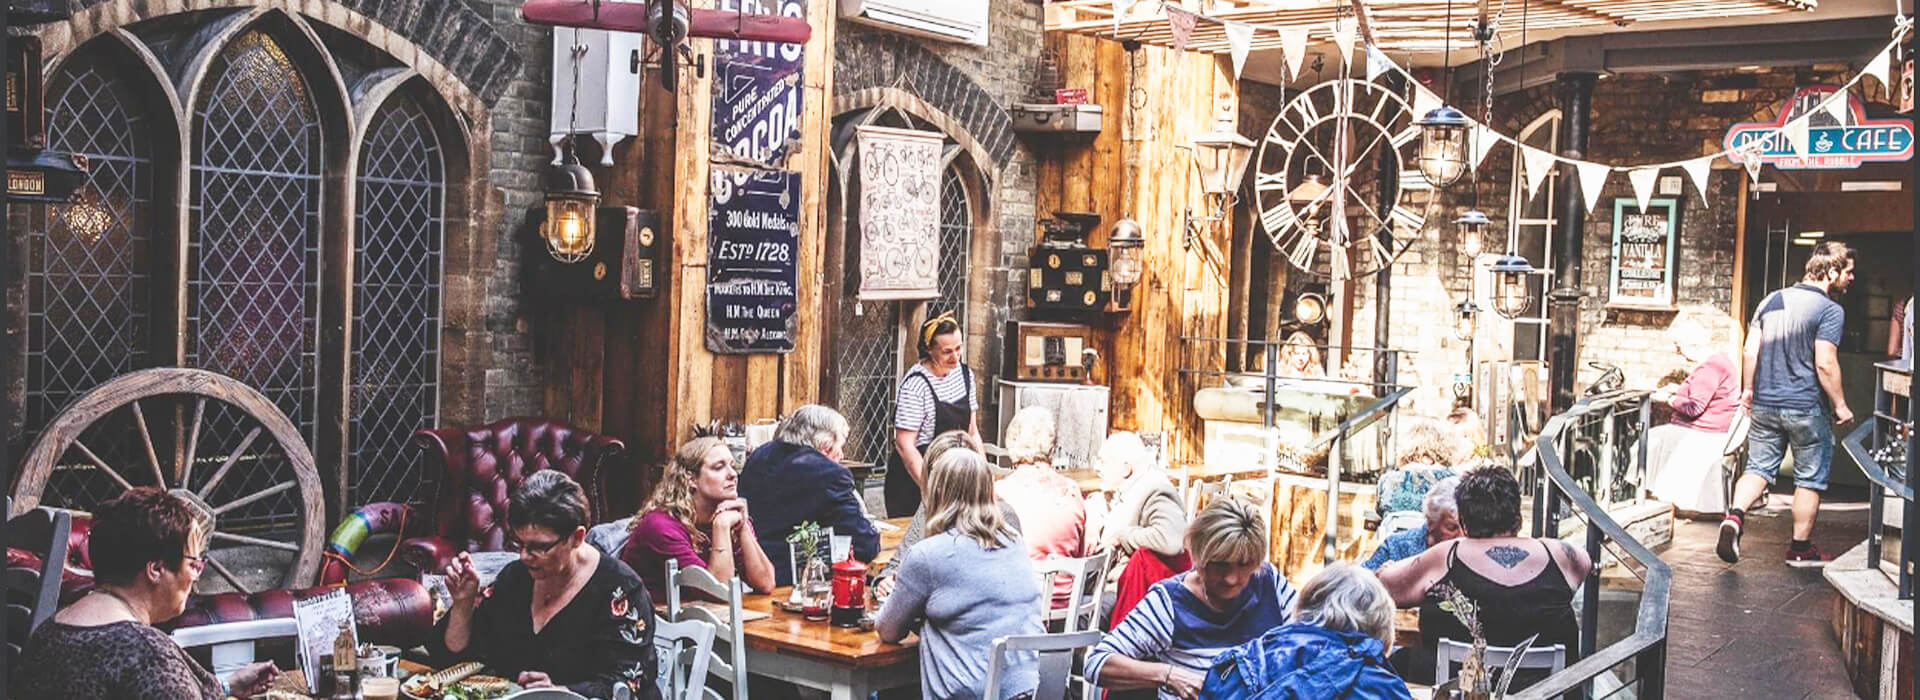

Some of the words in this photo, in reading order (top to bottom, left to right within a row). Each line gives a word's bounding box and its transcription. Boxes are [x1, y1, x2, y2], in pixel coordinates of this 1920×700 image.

[725, 79, 785, 143] CONCENTRATED
[732, 86, 758, 121] PURE
[1742, 132, 1794, 153] RISIN
[1842, 128, 1903, 151] CAFE
[8, 179, 41, 192] LONDON
[726, 210, 742, 228] 300
[744, 210, 760, 229] Gold
